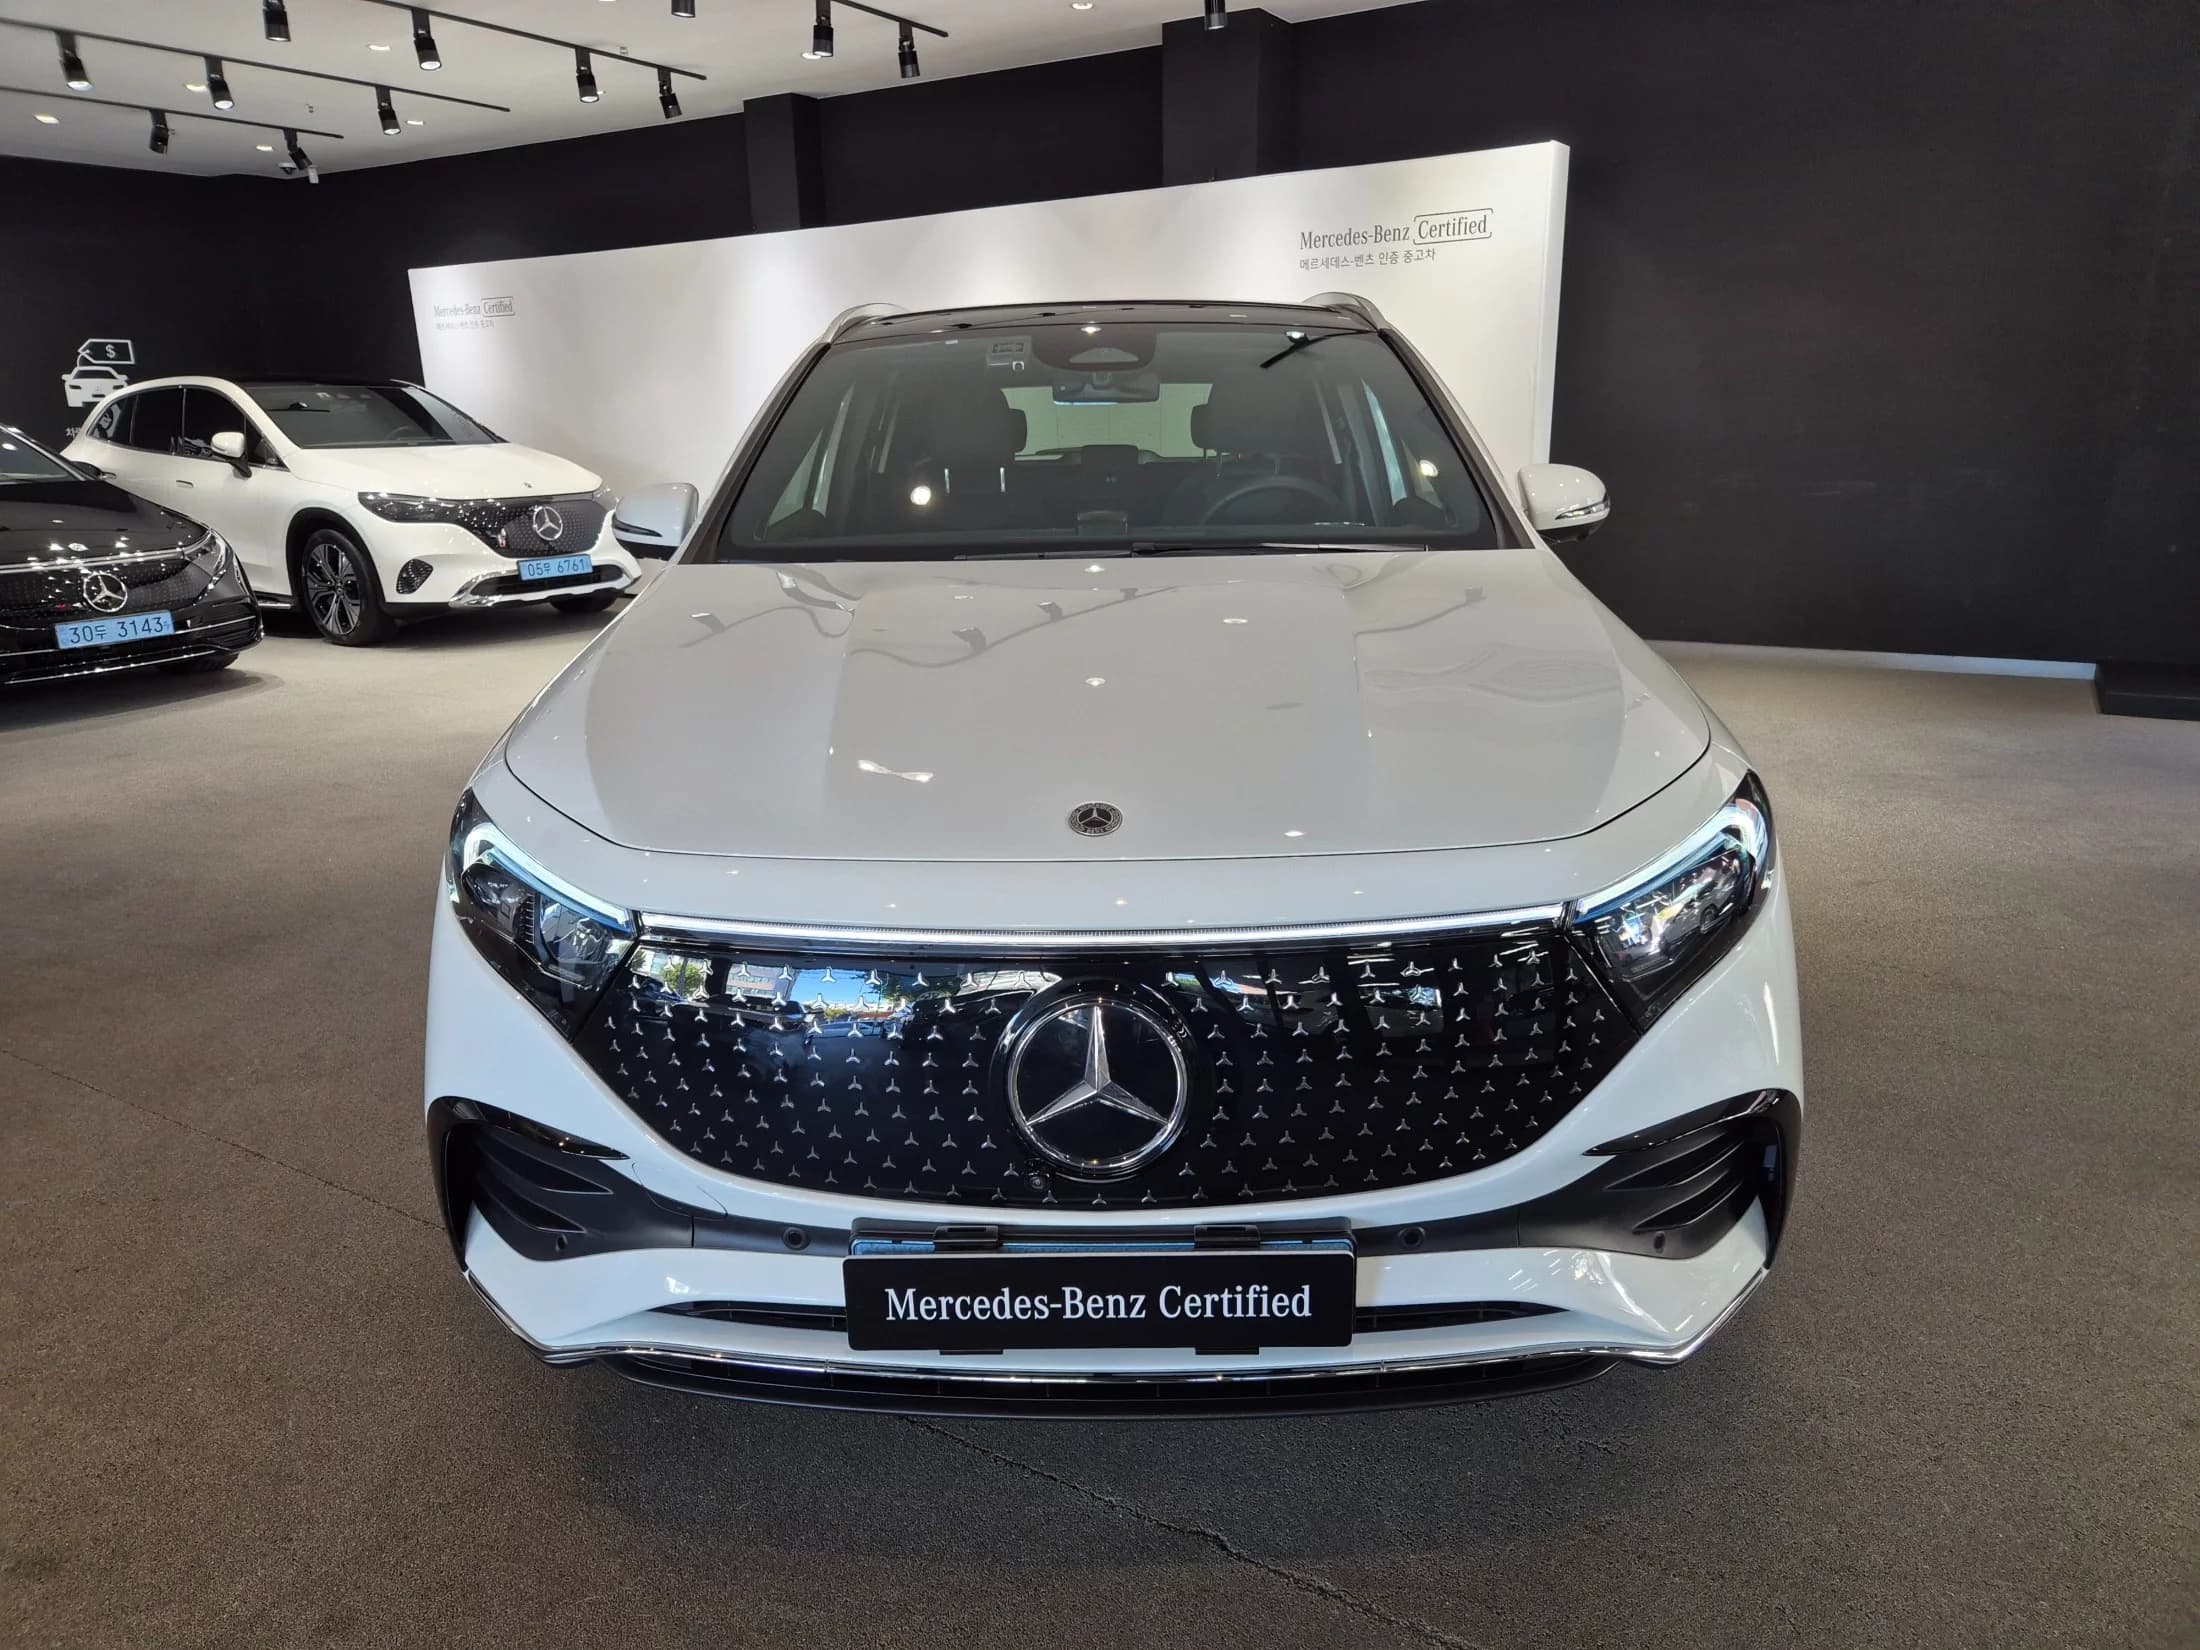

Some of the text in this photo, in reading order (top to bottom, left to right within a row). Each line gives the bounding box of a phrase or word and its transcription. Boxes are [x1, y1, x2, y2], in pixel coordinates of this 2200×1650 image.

[1299, 214, 1487, 250] Mercedes-Benz Certified
[1299, 248, 1436, 271] 메르세데스-벤츠 인증 중고차
[483, 299, 513, 315] Certified
[527, 558, 585, 577] 05무 6761
[69, 617, 164, 644] 30두 3143
[884, 1284, 1313, 1321] Mercedes-Benz Certified
